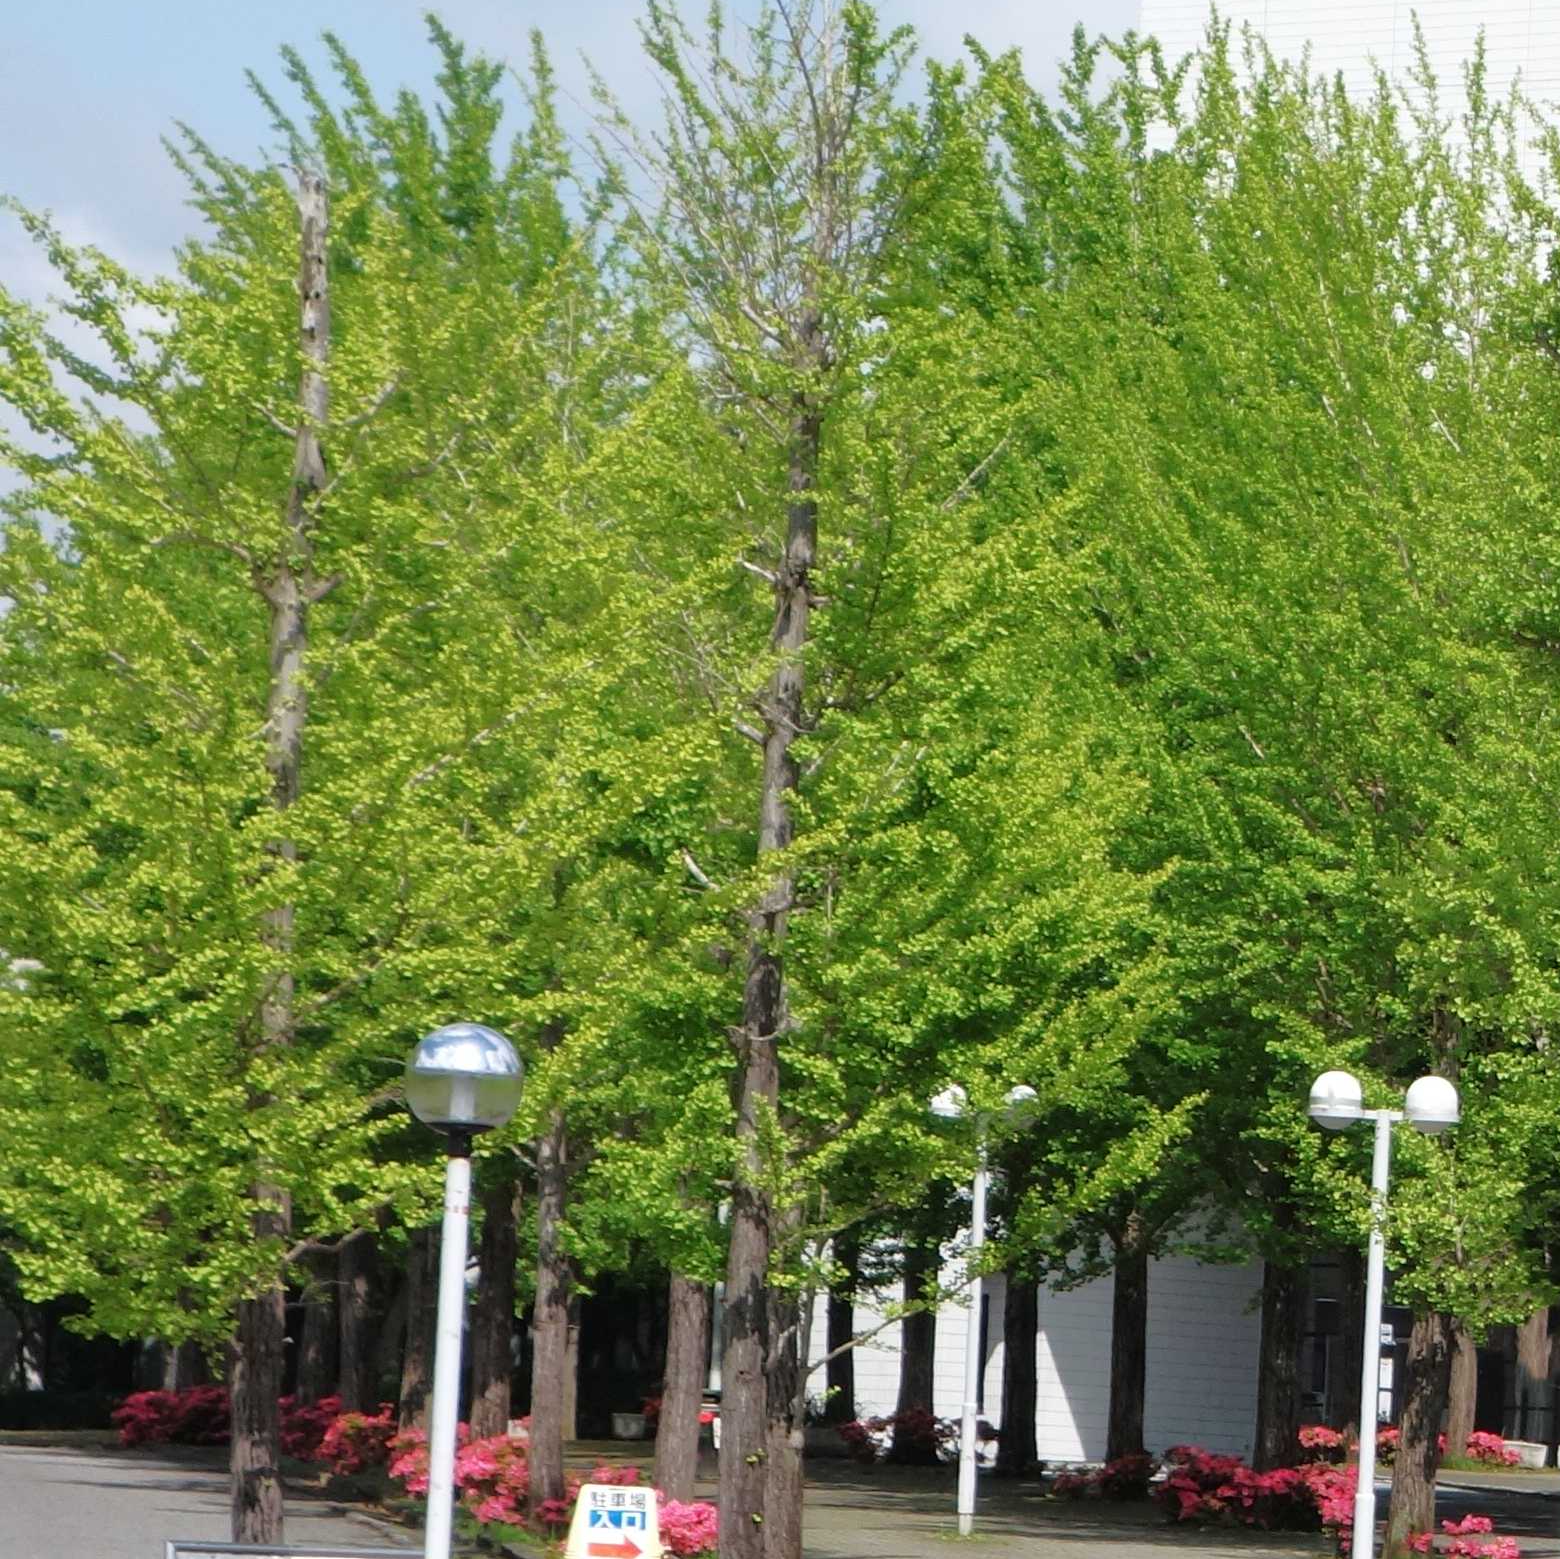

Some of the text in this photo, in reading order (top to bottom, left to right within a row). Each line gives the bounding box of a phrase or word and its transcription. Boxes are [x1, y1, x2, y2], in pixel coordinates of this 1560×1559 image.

[590, 1488, 646, 1509] 駐車場
[592, 1510, 643, 1529] 入口
